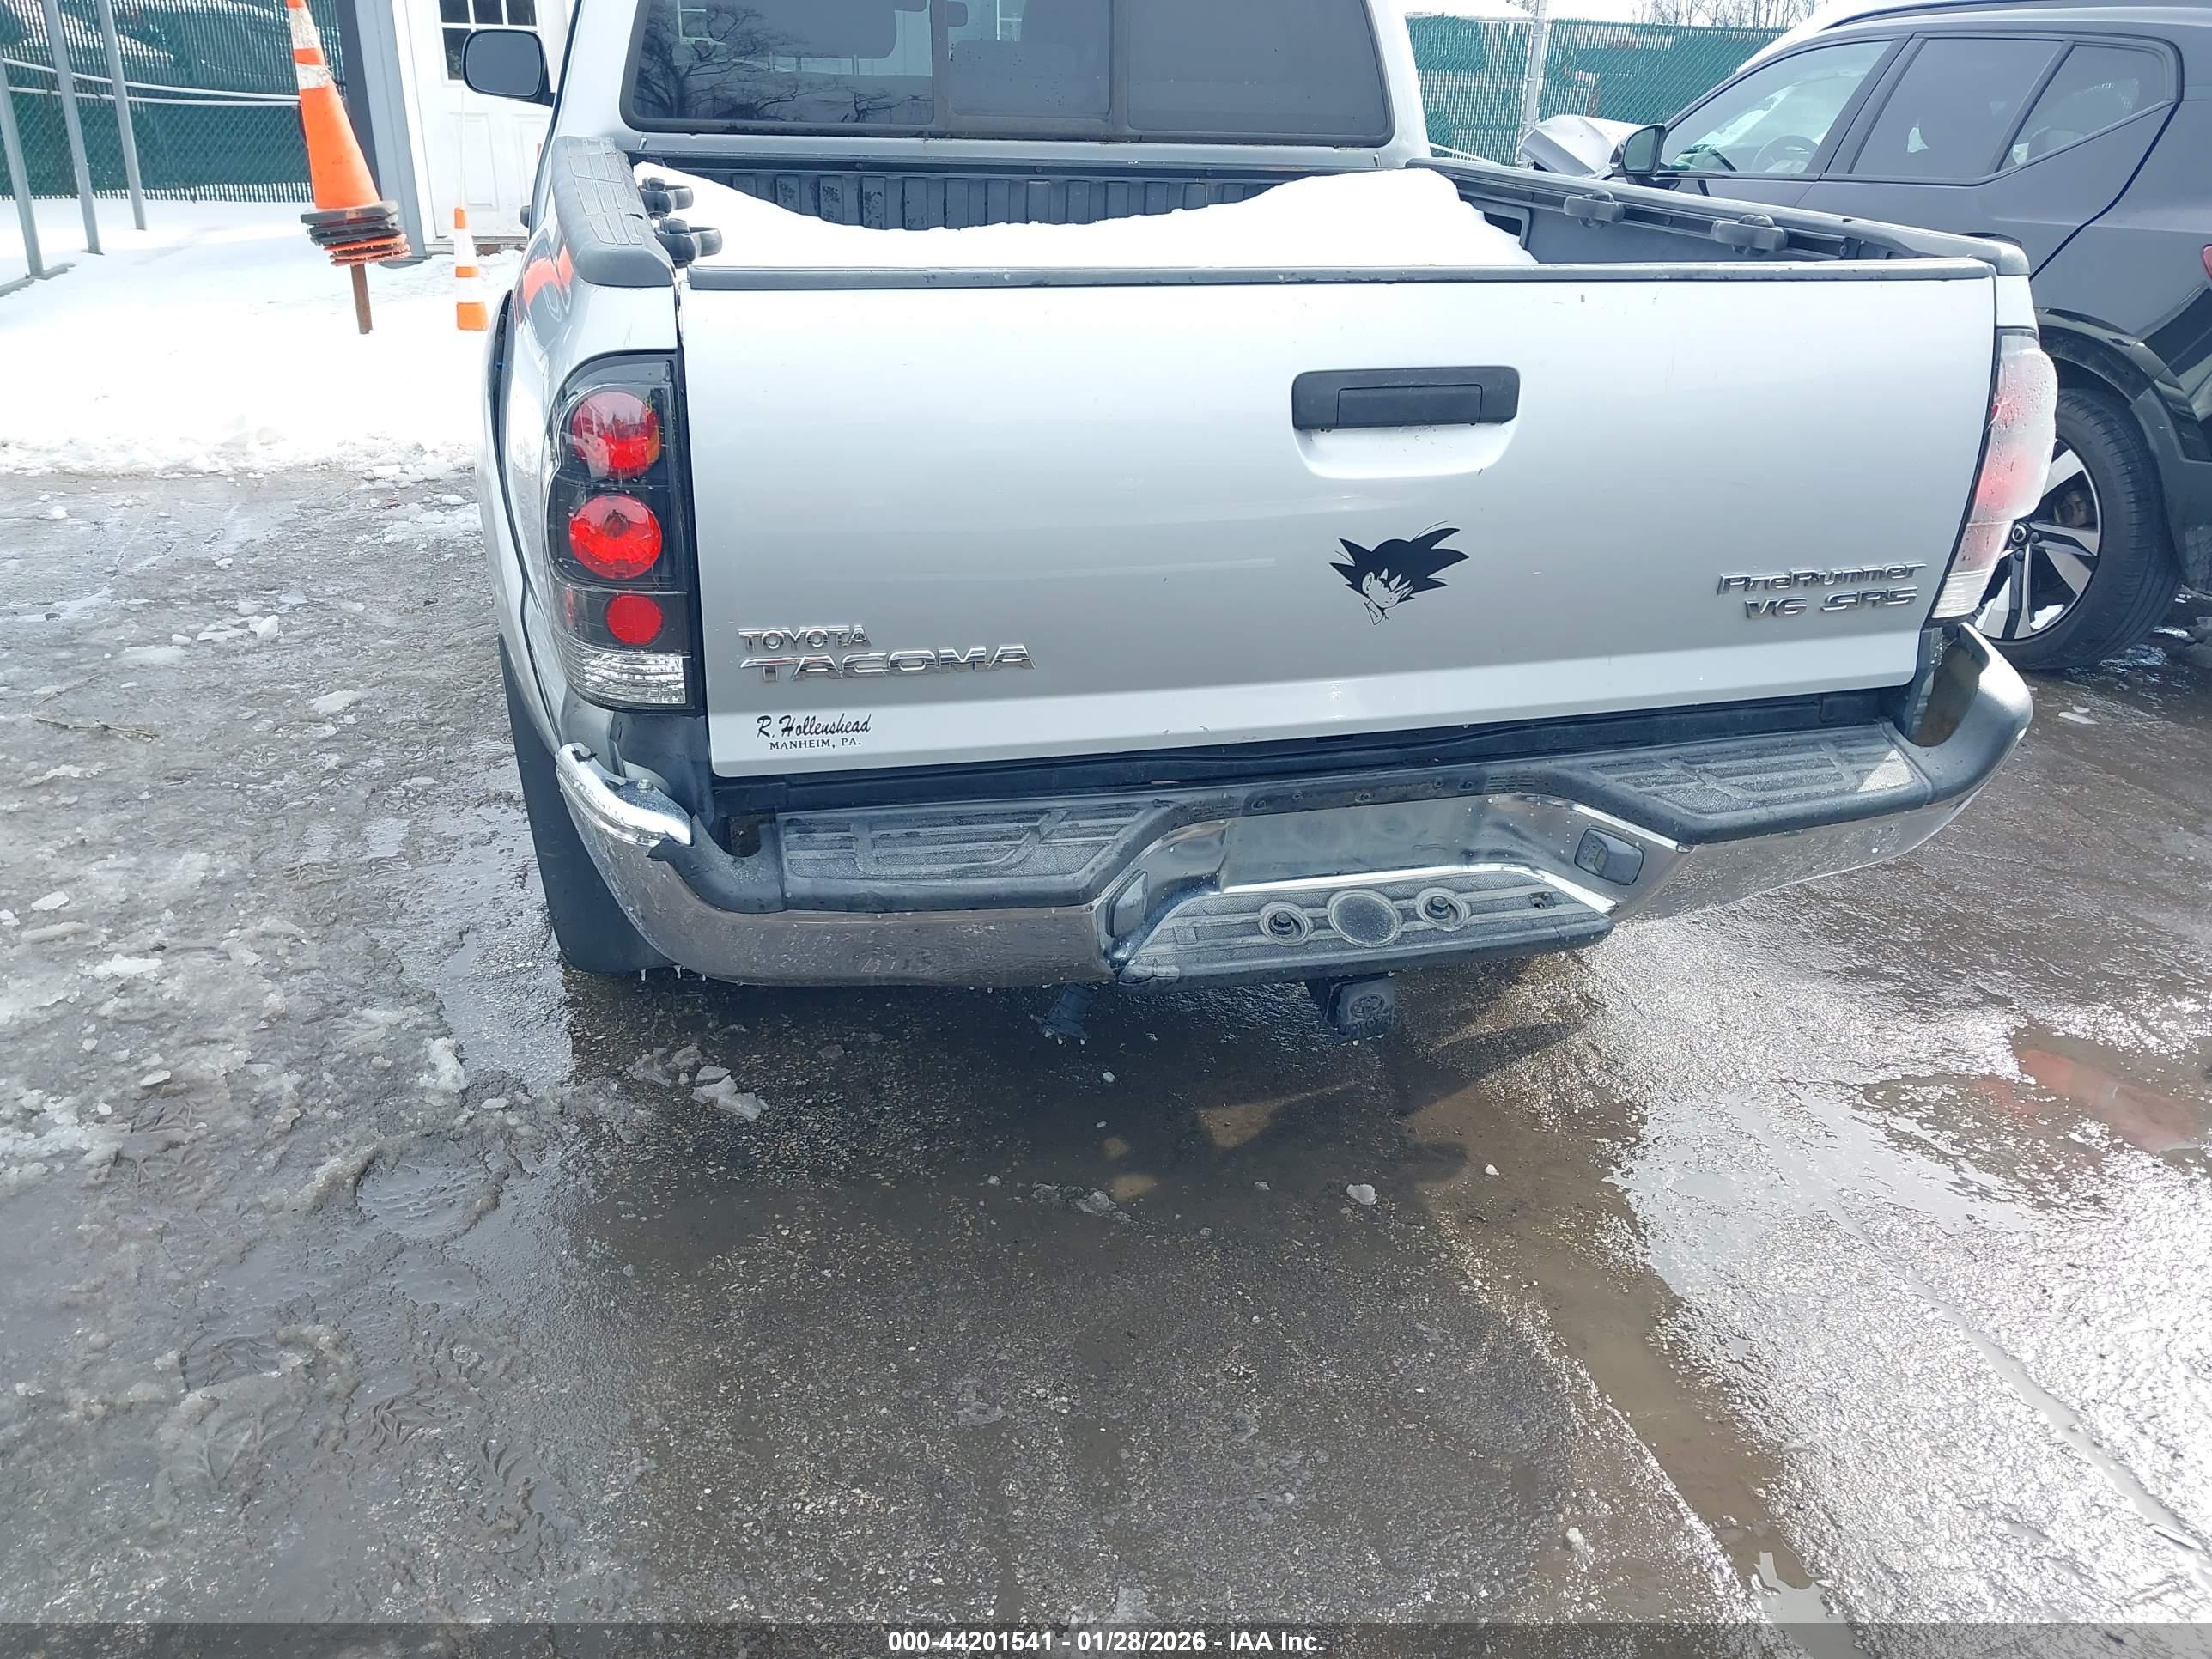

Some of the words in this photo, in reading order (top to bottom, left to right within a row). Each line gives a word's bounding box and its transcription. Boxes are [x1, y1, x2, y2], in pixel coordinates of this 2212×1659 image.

[1717, 561, 1927, 594] PreRunner
[1745, 597, 1807, 619] V6
[1820, 585, 1919, 611] SR5
[738, 624, 871, 650] TOYOTA
[739, 644, 1036, 682] TACOMA
[757, 714, 775, 738] R.
[779, 713, 872, 737] Hollenshead
[769, 738, 836, 750] MANHEIM,
[841, 738, 861, 746] PA.
